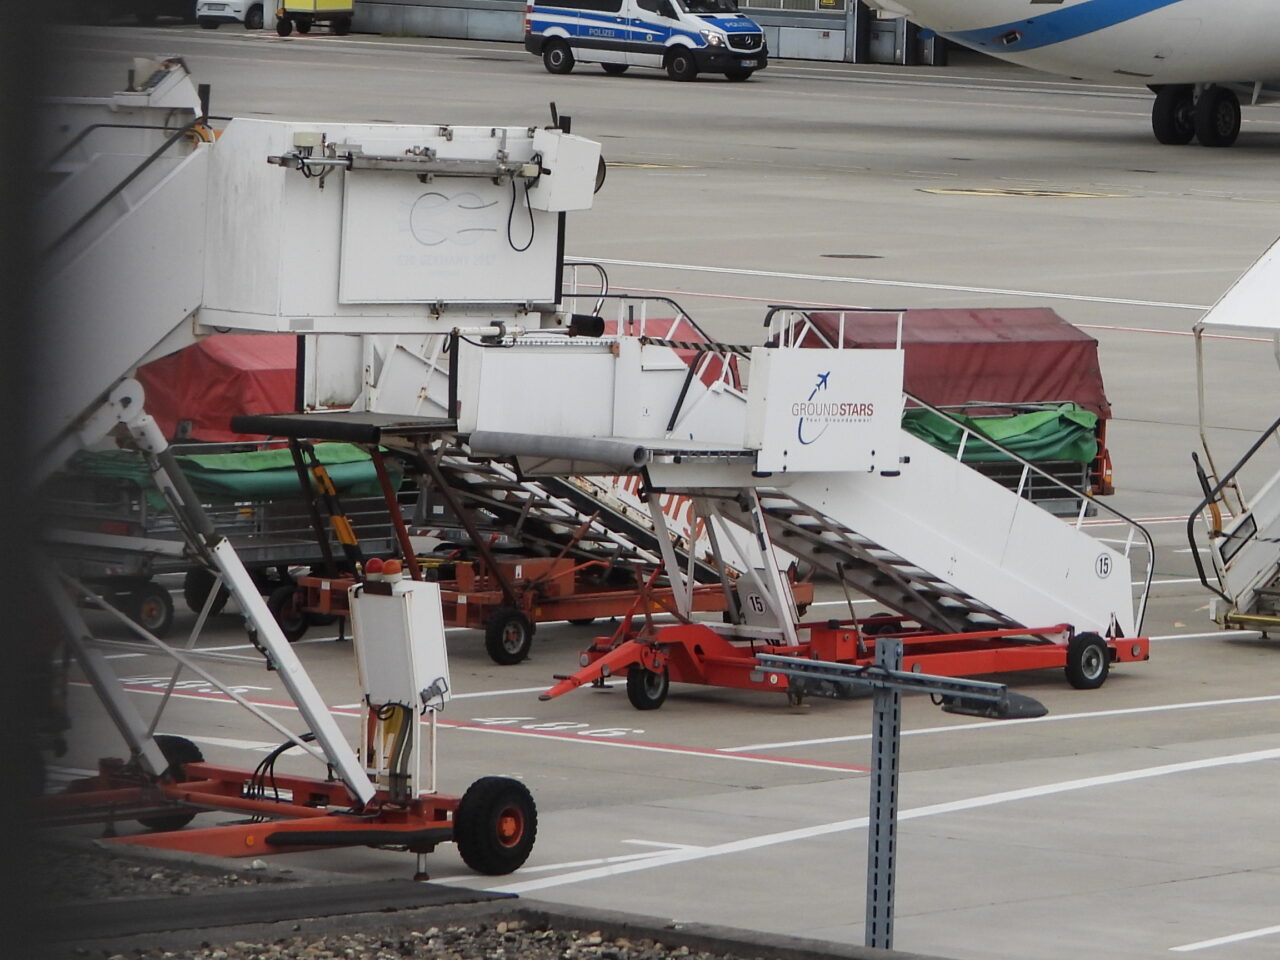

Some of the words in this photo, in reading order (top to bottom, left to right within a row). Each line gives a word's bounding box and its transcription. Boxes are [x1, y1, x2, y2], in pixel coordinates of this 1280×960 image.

[588, 27, 615, 38] POLIZEI
[791, 402, 874, 417] GROUNDSTARS
[1099, 556, 1109, 575] 15
[749, 596, 764, 612] 15
